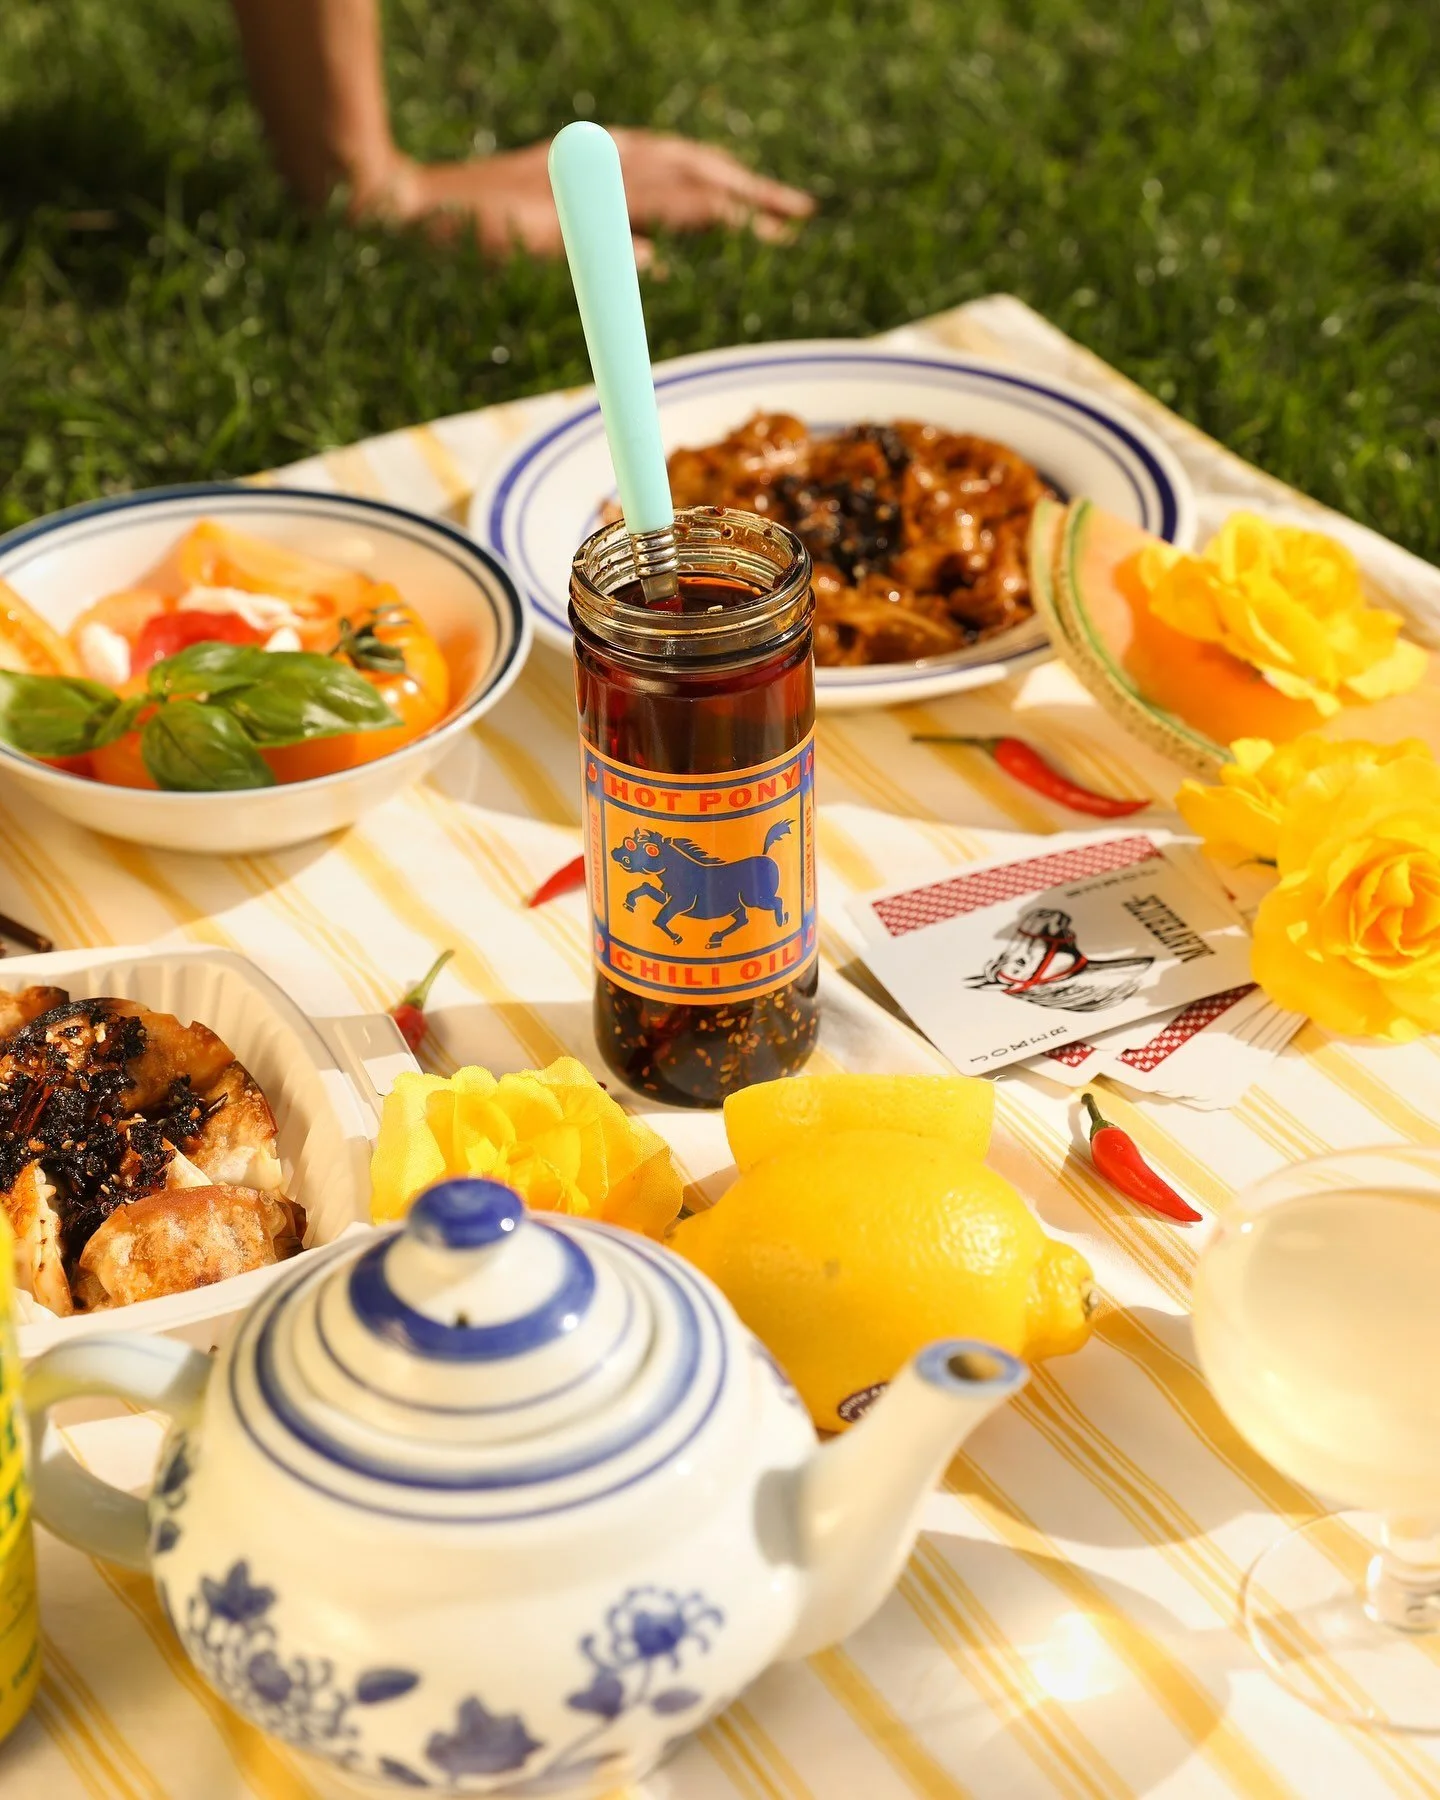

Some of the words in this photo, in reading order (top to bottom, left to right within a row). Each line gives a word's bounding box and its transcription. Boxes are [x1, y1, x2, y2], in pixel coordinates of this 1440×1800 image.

[611, 777, 682, 812] HOT
[699, 766, 799, 812] PONY
[591, 812, 600, 837] BIG
[592, 840, 602, 903] FLAVOUR
[616, 950, 720, 986] CHILI
[739, 946, 796, 981] OIL
[970, 1026, 1067, 1063] JOKER
